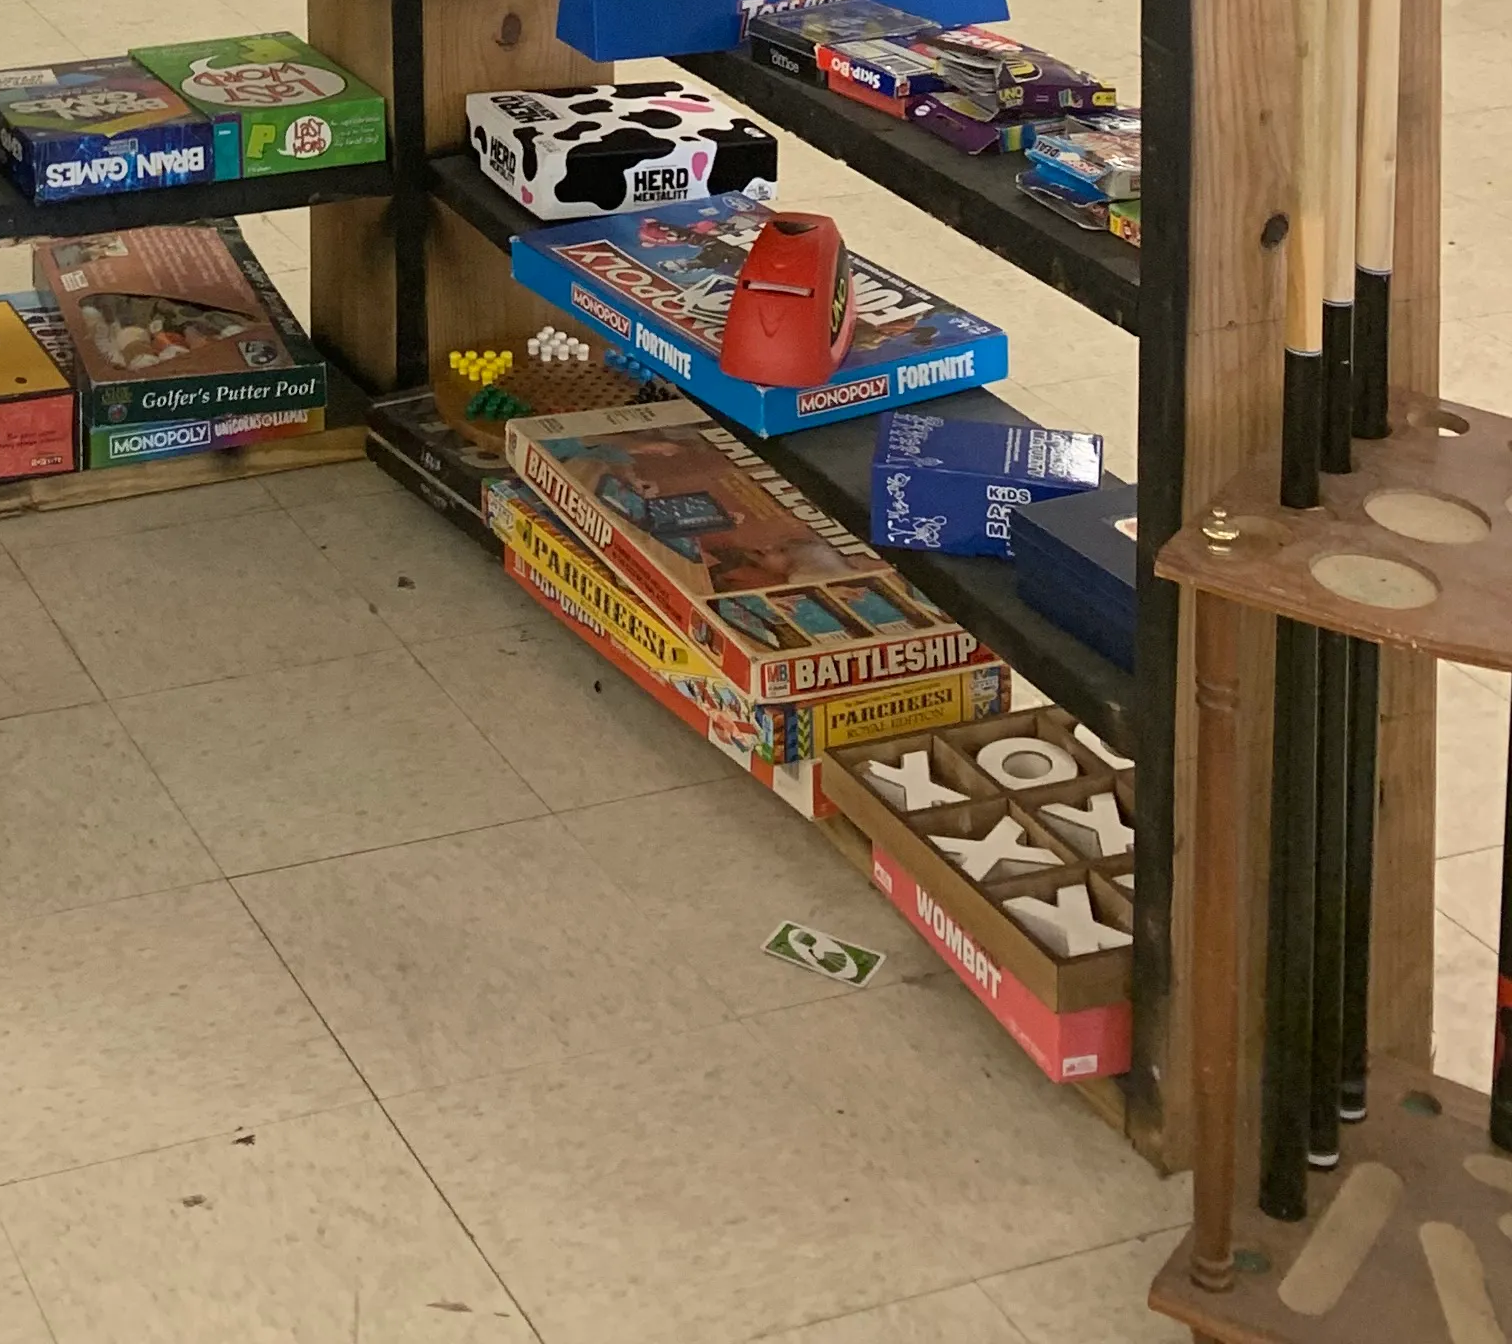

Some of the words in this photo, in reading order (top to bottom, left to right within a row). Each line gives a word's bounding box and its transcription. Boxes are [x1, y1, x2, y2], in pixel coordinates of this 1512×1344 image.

[999, 85, 1023, 100] UNO
[137, 145, 205, 179] BRAIN
[489, 135, 516, 171] HERD
[45, 155, 129, 188] GAMES
[634, 167, 689, 193] HERD
[633, 189, 689, 204] MENTALITY
[573, 290, 631, 335] MONOPOLY
[635, 322, 692, 380] FORTNITE
[141, 387, 211, 412] Golfer's
[215, 385, 271, 403] Putter
[276, 378, 316, 398] Pool
[800, 376, 888, 415] MONOPOLY
[897, 350, 975, 395] FORTNITE
[112, 424, 209, 456] MONOPOLY
[528, 448, 614, 548] BATTLESHIP
[533, 537, 670, 664] PARCHEESI
[767, 663, 788, 683] MB
[795, 632, 977, 690] BATTLESHIP
[830, 687, 954, 730] PARCHEESI
[915, 883, 1003, 1000] WOMBAT
